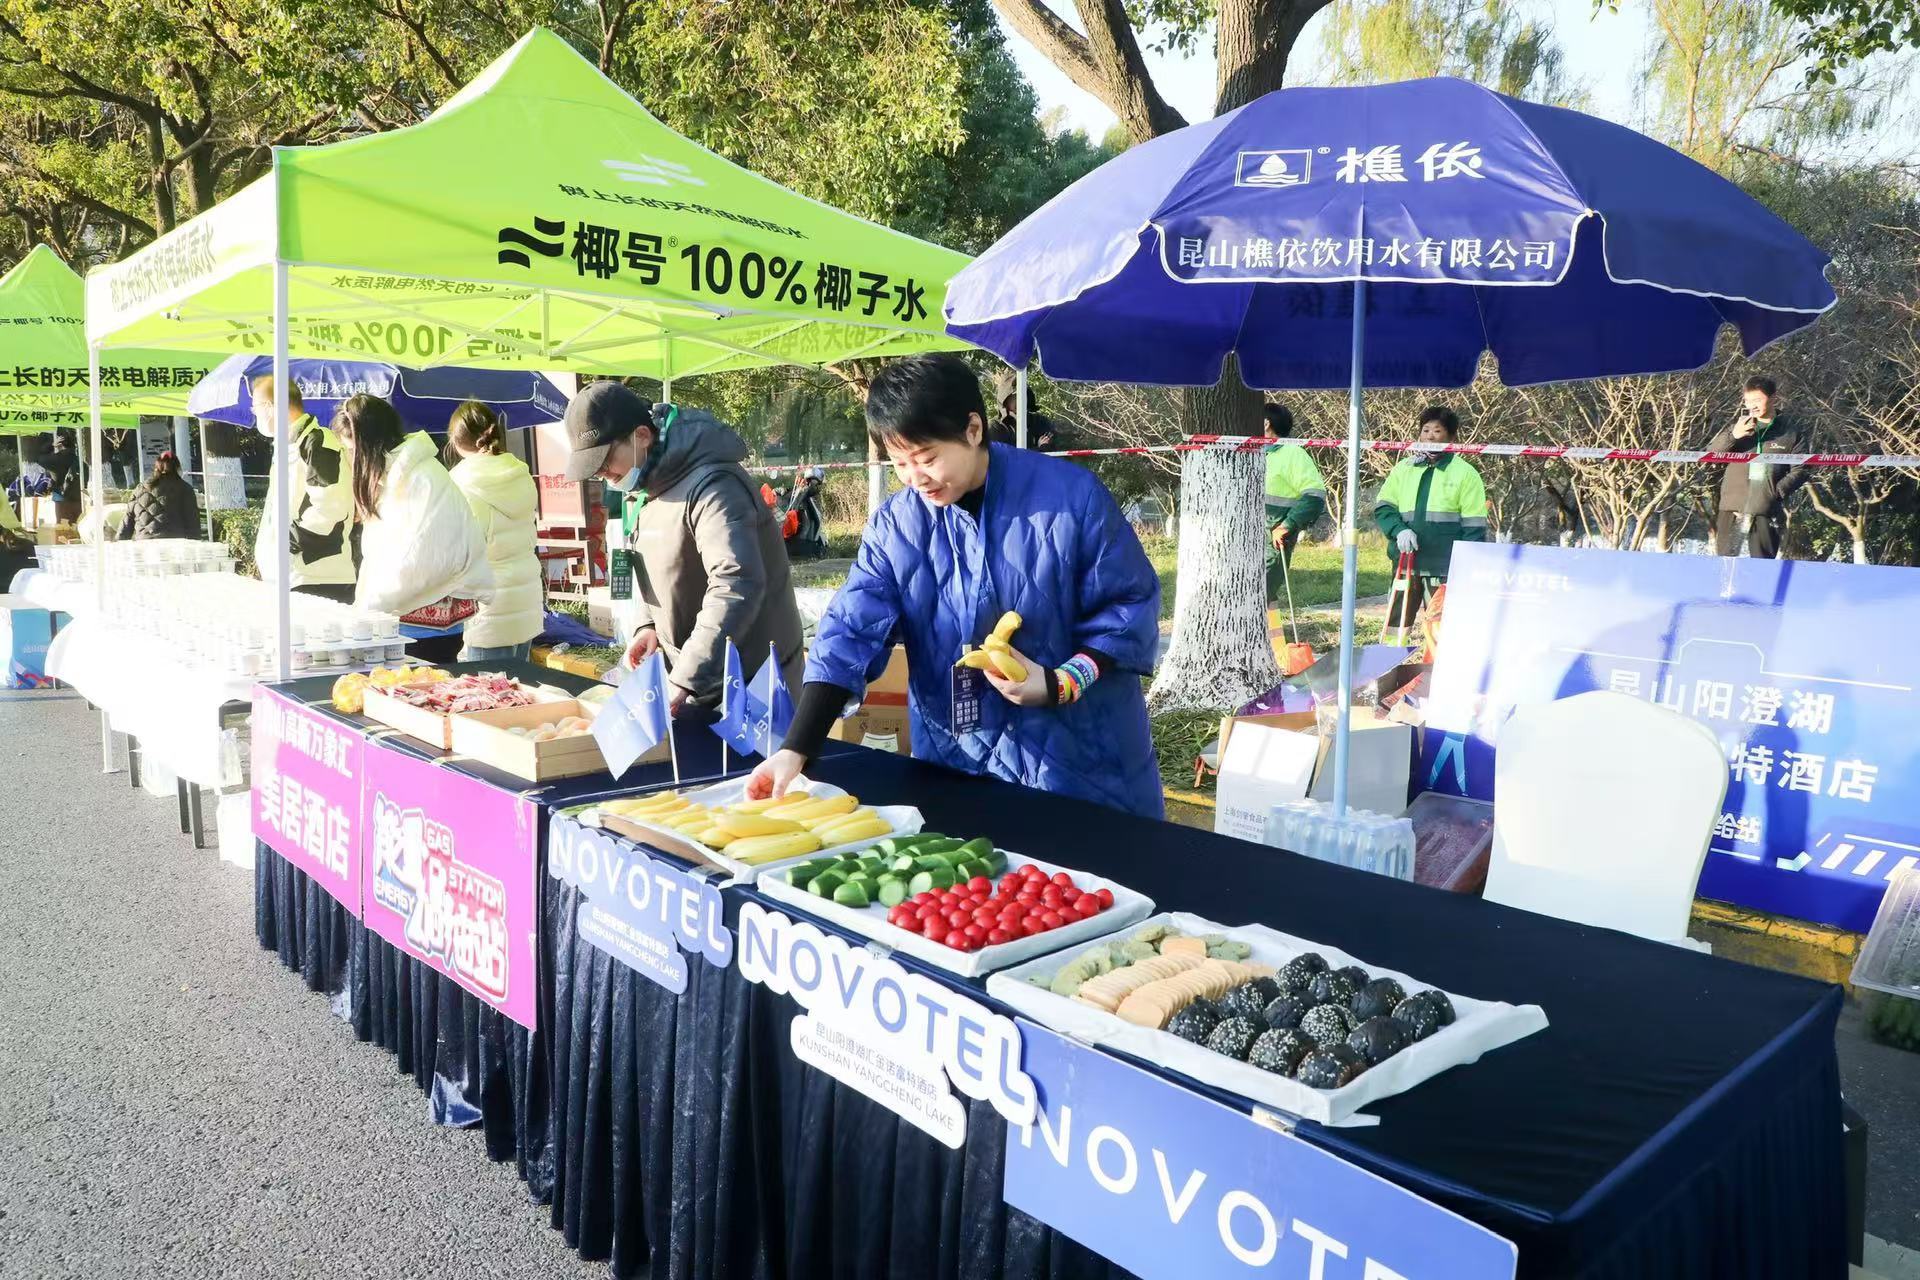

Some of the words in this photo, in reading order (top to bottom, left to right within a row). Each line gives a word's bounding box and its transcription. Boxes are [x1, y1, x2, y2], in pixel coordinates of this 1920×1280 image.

[1336, 141, 1486, 184] 樵依
[558, 183, 810, 240] 树上长的天然电解质水
[1177, 235, 1557, 271] 昆山樵依饮用水有限公司
[1610, 669, 1835, 735] 昆山阳澄湖
[1726, 742, 1879, 803] 特酒店
[260, 768, 350, 881] 美居酒店
[426, 827, 451, 852] GAS
[448, 866, 505, 910] STATION
[550, 827, 726, 953] NOVOTEL
[660, 963, 681, 983] LAKE
[744, 916, 1026, 1106] NOVOTEL
[799, 1033, 851, 1070] KUNSHAN
[853, 1061, 923, 1111] YANGCHENG
[925, 1105, 955, 1132] LAKE
